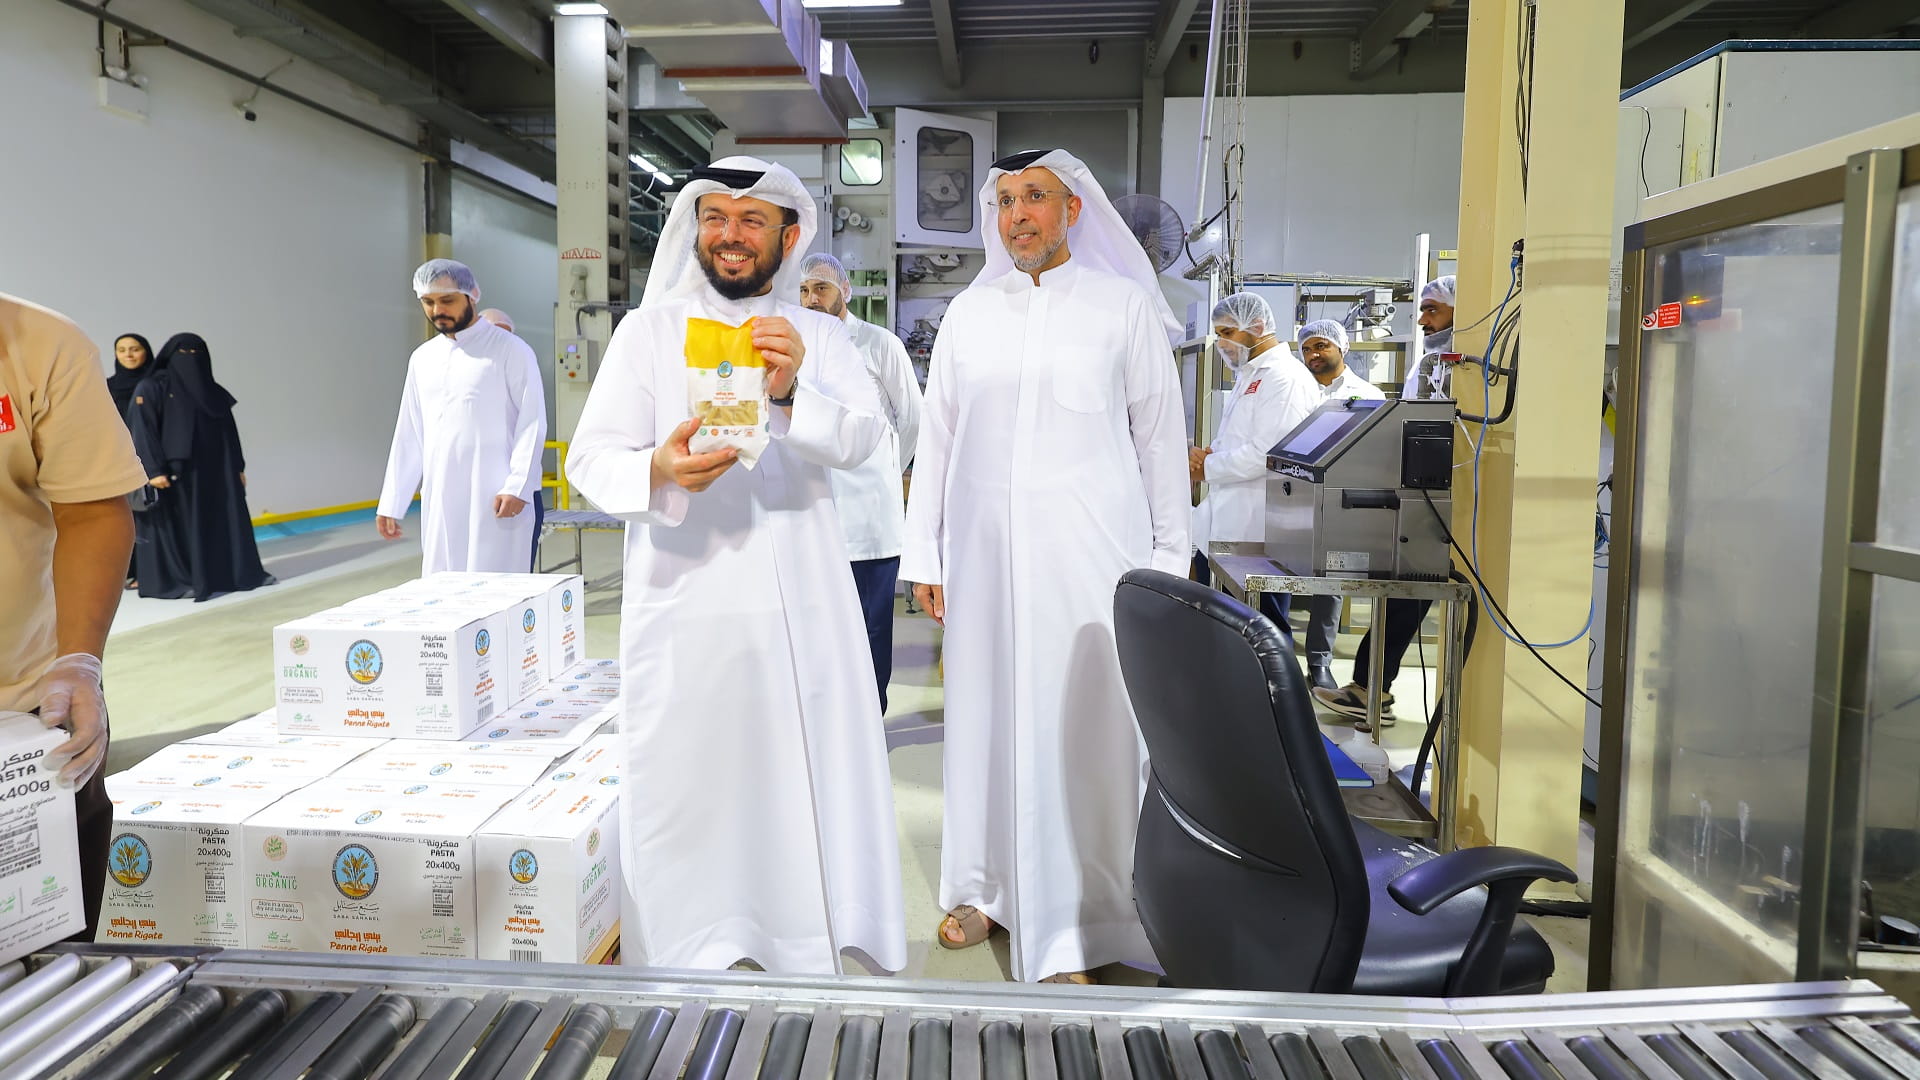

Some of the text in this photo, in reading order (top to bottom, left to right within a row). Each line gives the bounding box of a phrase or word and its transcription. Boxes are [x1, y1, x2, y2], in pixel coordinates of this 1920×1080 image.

[420, 651, 448, 659] 20x400g
[284, 668, 318, 678] ORGANIC
[344, 719, 390, 728] Penne Rigate
[0, 764, 36, 783] STA
[0, 780, 50, 801] x400g
[198, 848, 231, 858] 20x400g
[430, 849, 455, 857] PASTA
[426, 860, 460, 871] 20x400g
[256, 876, 298, 890] ORGANIC
[106, 929, 163, 940] Penne Rigate
[523, 926, 544, 934] Rigate
[330, 942, 388, 953] Penne Rigate
[512, 938, 538, 947] 20x400g
